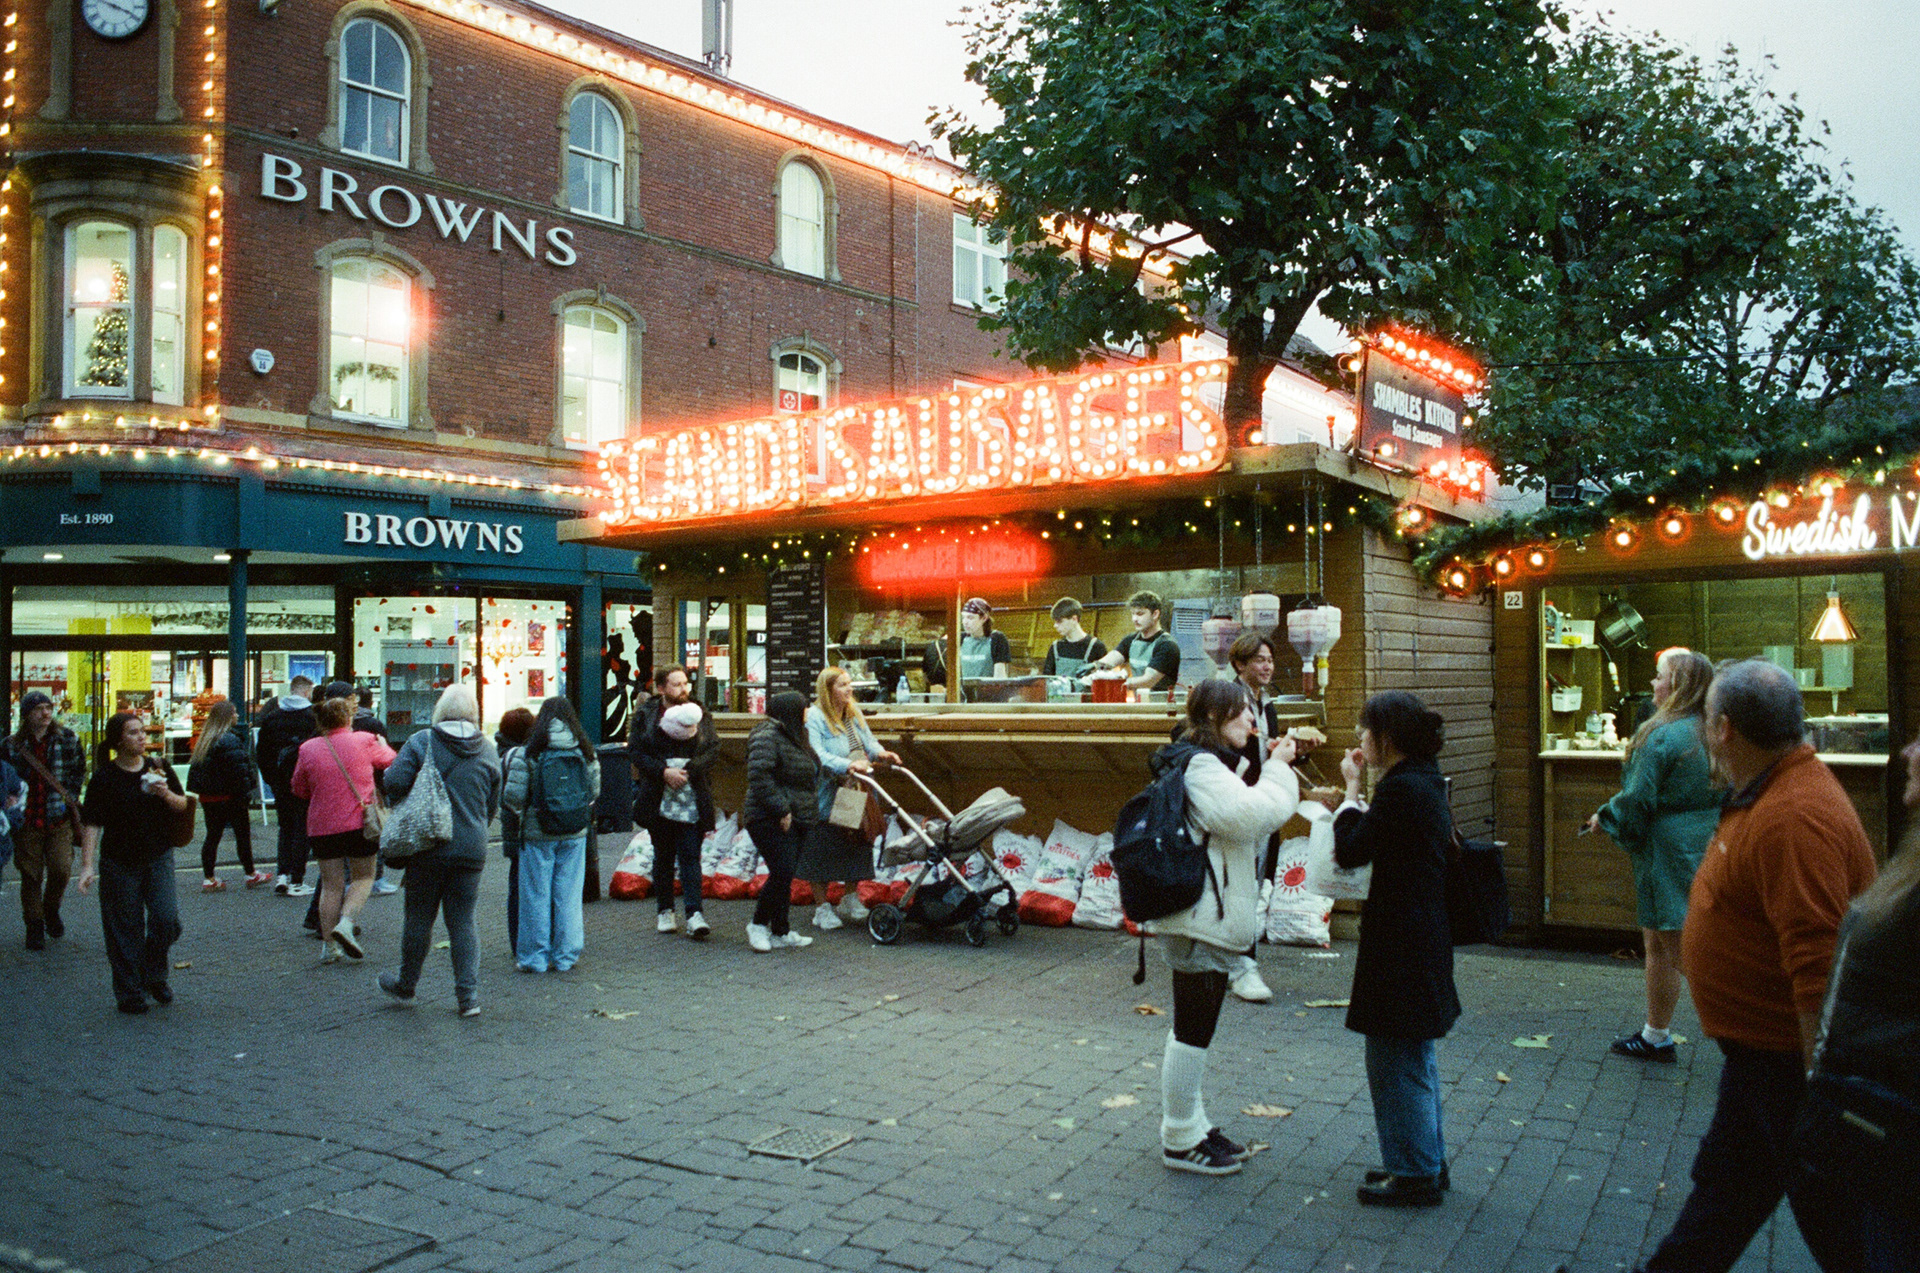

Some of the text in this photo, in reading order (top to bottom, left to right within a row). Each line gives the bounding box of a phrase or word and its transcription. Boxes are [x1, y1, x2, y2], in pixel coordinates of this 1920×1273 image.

[261, 152, 577, 267] BROWNS
[1373, 381, 1421, 422] SHAMBLES
[598, 360, 1229, 525] SCANDI SAUSAGES
[60, 513, 114, 524] Est. 1890
[344, 512, 524, 554] BROWNS
[1743, 493, 1877, 560] Swedish
[1507, 594, 1520, 606] 22
